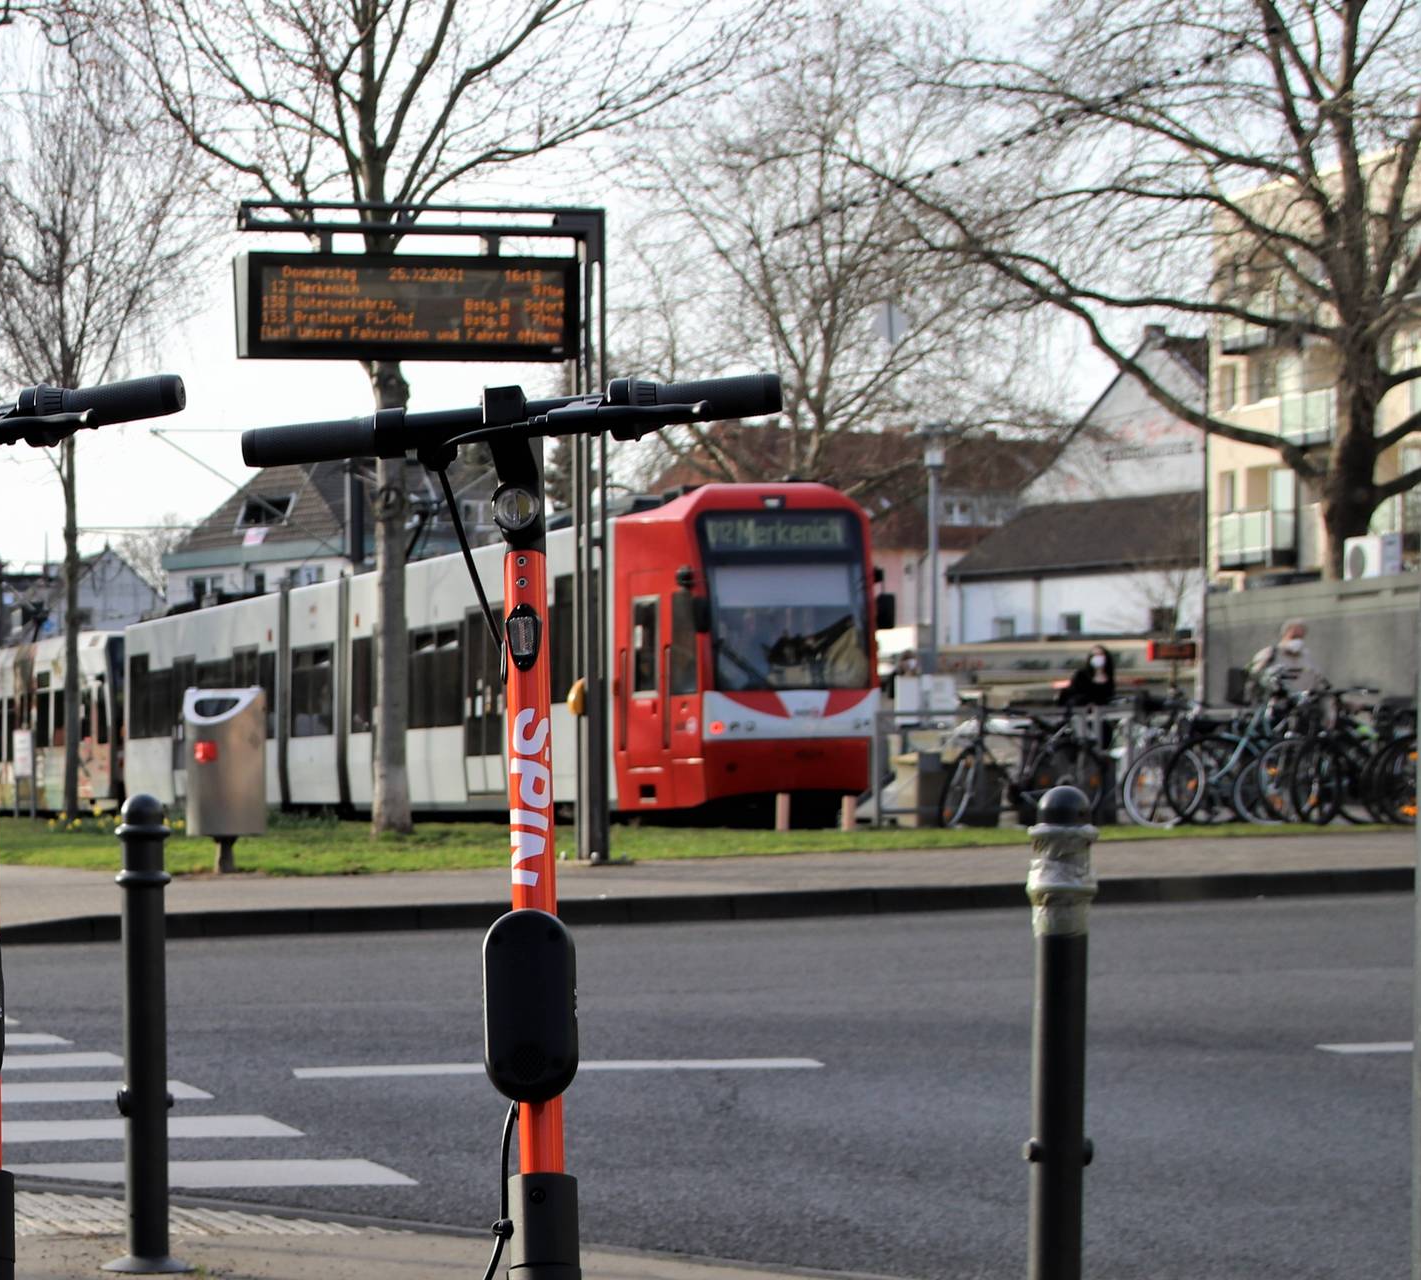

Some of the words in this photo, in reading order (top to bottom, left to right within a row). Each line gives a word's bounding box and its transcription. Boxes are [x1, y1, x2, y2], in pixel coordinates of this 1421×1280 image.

[282, 265, 357, 281] Donnerstag
[271, 280, 289, 293] 12
[293, 280, 360, 295] Merkenich
[293, 311, 357, 324] Breslauer
[297, 326, 343, 340] Unsere
[349, 326, 430, 341] Fahrerinnen
[436, 328, 460, 341] und
[466, 328, 510, 341] Fahrer
[737, 517, 843, 546] Merkenich
